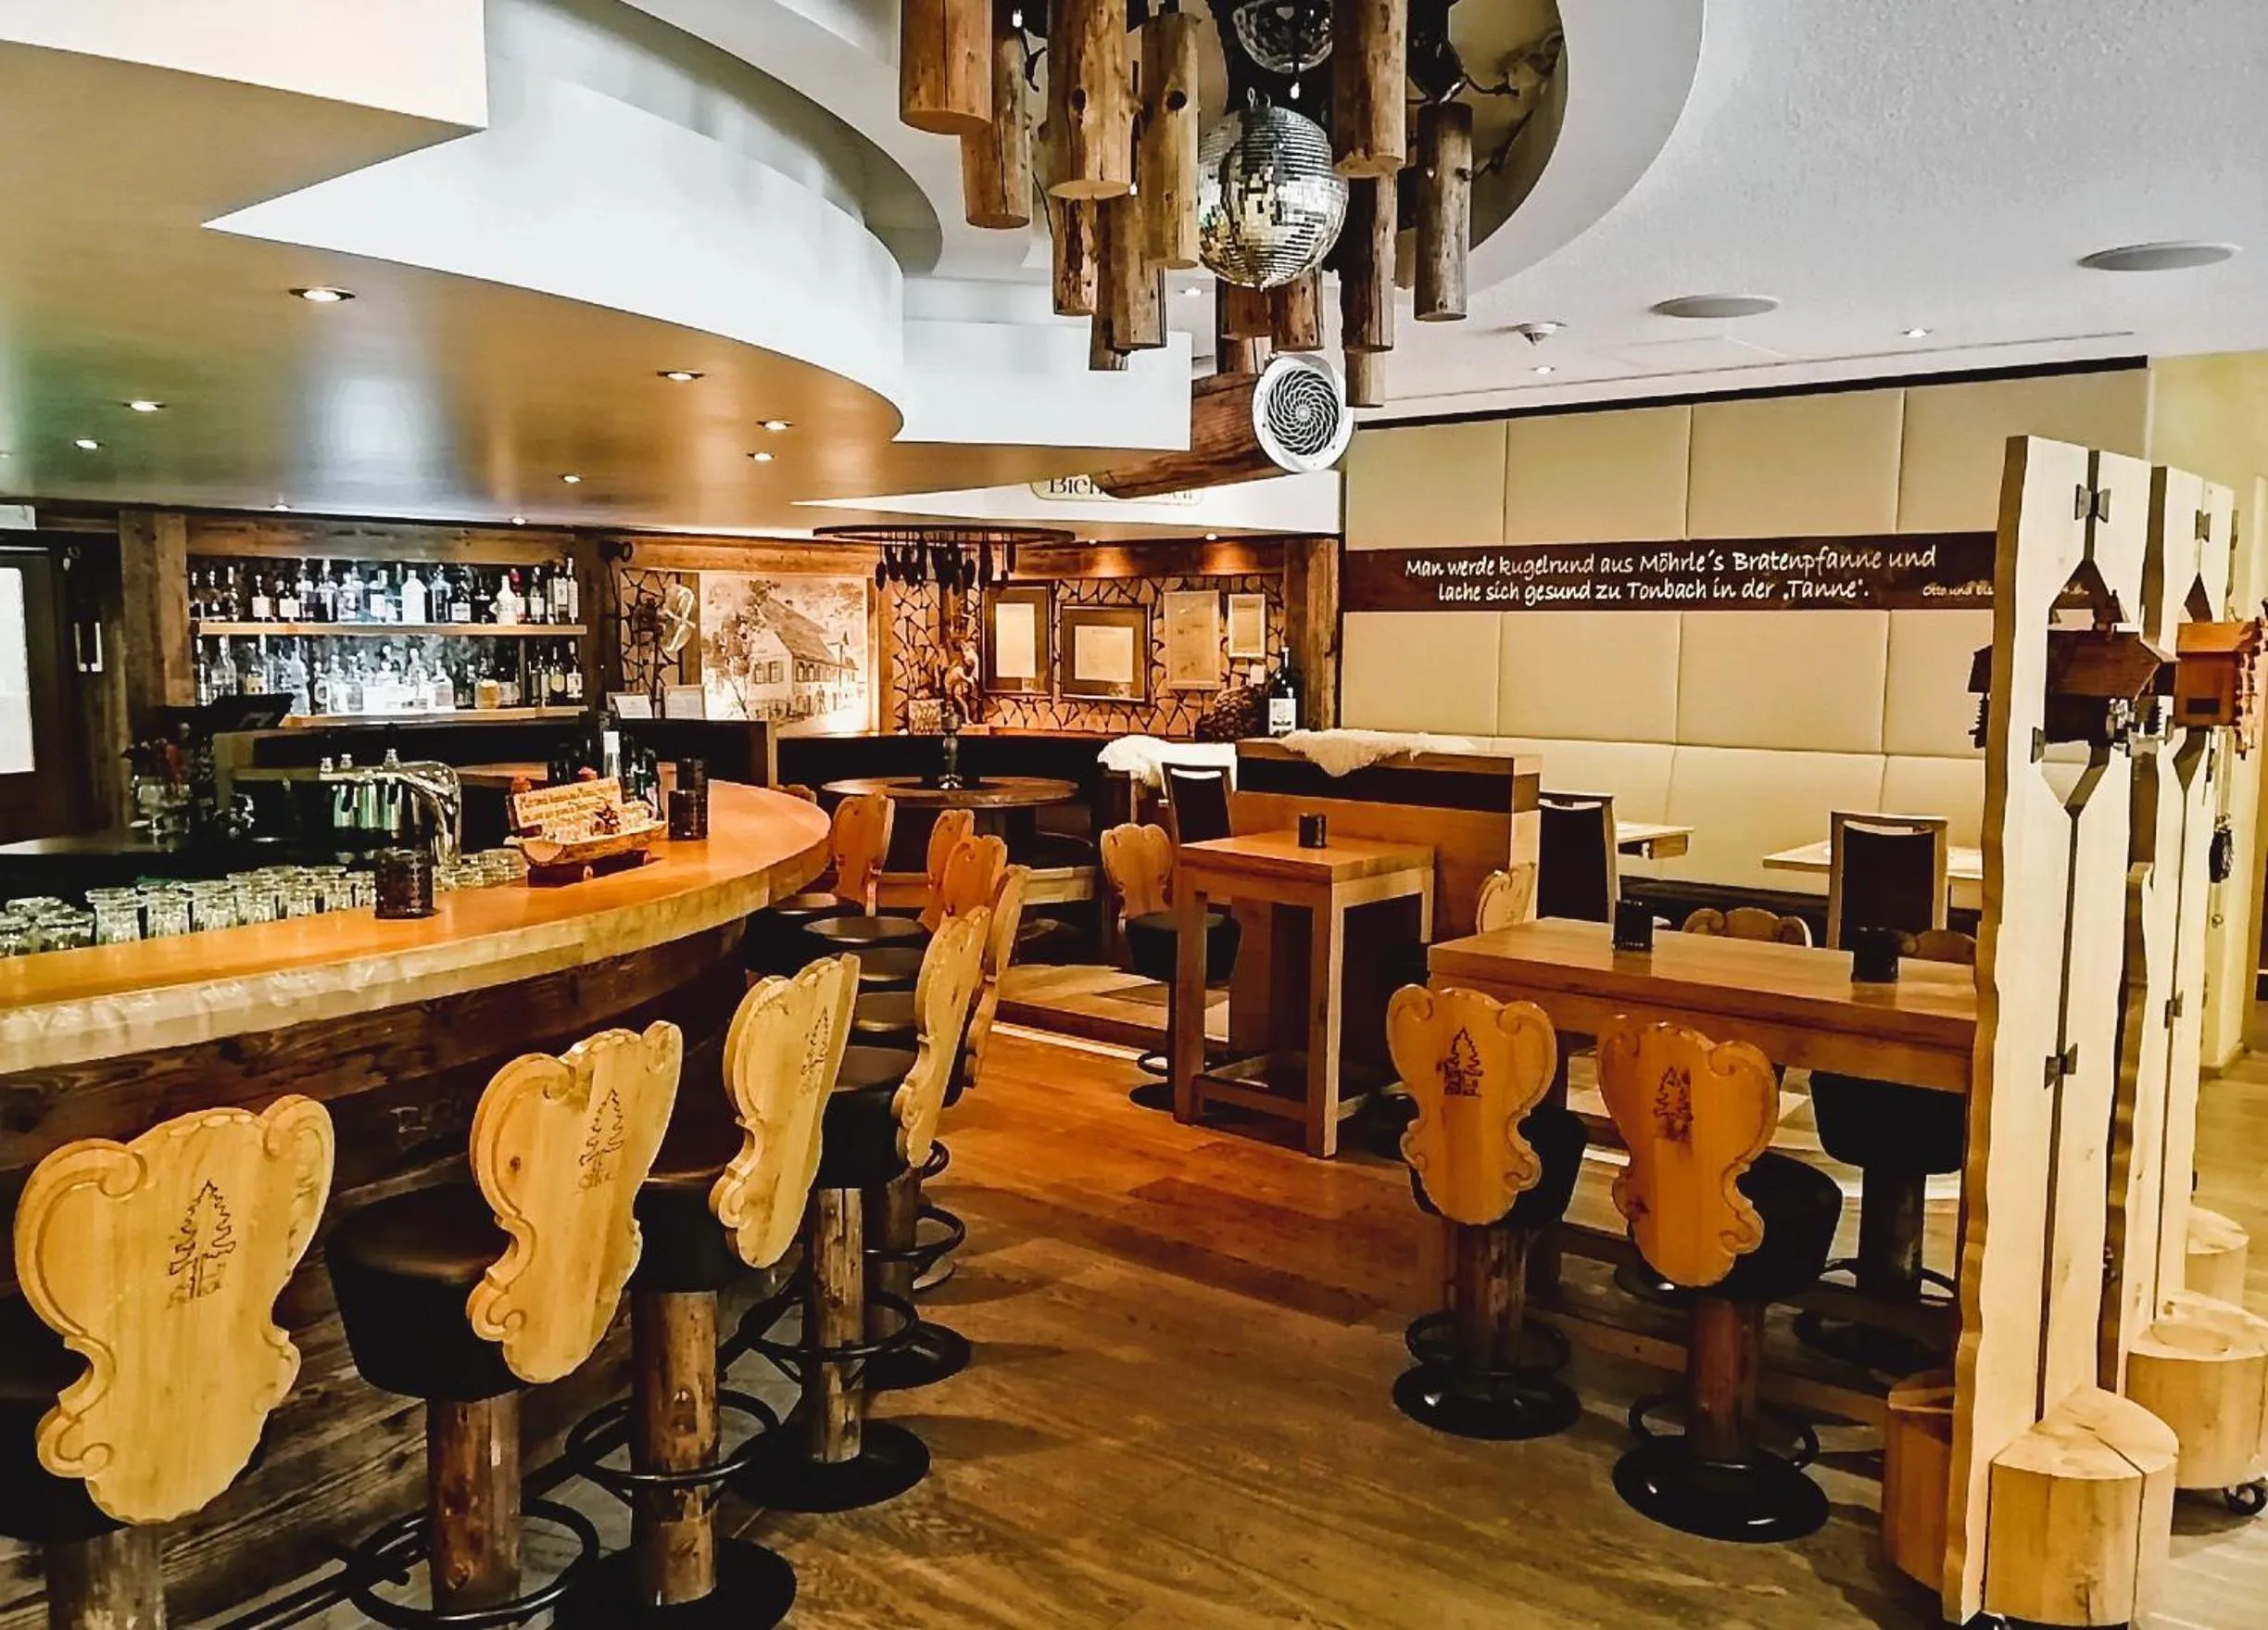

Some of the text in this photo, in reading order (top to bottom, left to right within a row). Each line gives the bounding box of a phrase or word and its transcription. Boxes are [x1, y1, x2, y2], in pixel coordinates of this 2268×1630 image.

[1405, 559, 1445, 576] Man
[1446, 555, 1495, 575] werde
[1498, 553, 1595, 582] kugelrund
[1600, 556, 1633, 574] aus
[1732, 545, 1883, 577] Bratenpfanne
[1887, 544, 1936, 568] und
[1438, 581, 1481, 601] lache
[1485, 580, 1519, 601] sich
[1523, 578, 1592, 607] gesund
[1594, 584, 1622, 600] zu
[1626, 577, 1707, 600] Tonbach
[1713, 576, 1737, 599] in
[1741, 576, 1776, 600] der
